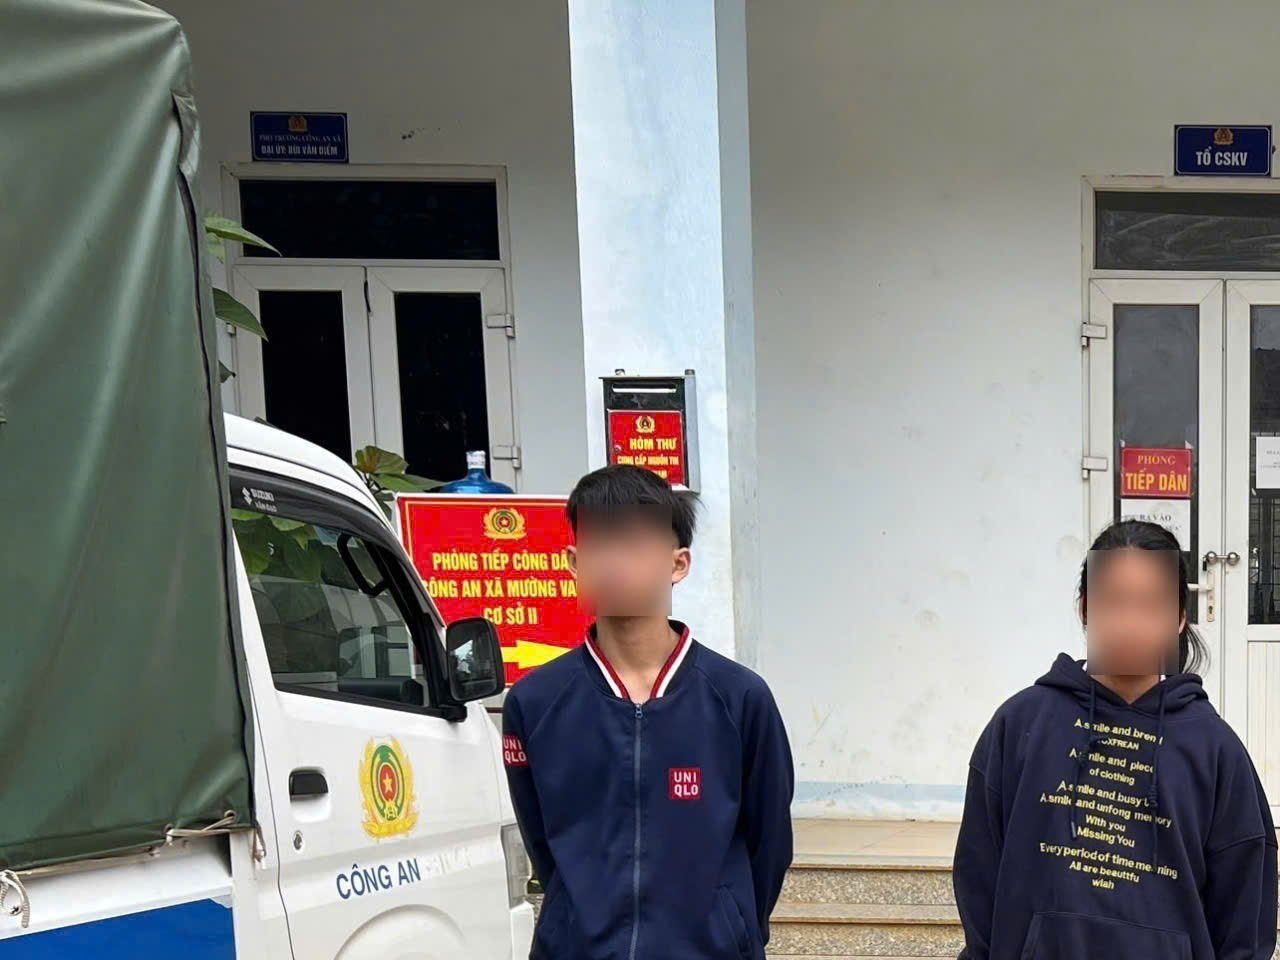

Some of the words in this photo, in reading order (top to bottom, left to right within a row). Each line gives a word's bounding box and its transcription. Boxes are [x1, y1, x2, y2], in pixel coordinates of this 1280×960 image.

[1195, 145, 1211, 166] TỔ
[1215, 151, 1248, 166] CSKV
[630, 436, 654, 450] HÒM
[656, 437, 677, 450] THƯ
[1126, 468, 1155, 490] TIẾP
[1160, 470, 1187, 491] DÂN
[432, 548, 478, 571] PHÒNG
[481, 547, 509, 571] TIẾP
[513, 549, 548, 571] CÔNG
[551, 550, 569, 571] DÂ
[462, 580, 482, 598] AN
[485, 577, 504, 598] XÃ
[508, 576, 556, 598] MƯỜNG
[560, 580, 577, 597] VA
[483, 606, 504, 625] CƠ
[506, 602, 525, 625] SỞ
[528, 608, 539, 625] II
[1074, 718, 1082, 728] A
[1112, 726, 1131, 736] and
[504, 738, 522, 750] UNI
[505, 750, 527, 764] QLO
[1069, 748, 1077, 758] A
[1107, 757, 1126, 768] and
[674, 771, 697, 783] UNI
[1089, 768, 1100, 776] of
[1100, 770, 1135, 786] clothing
[674, 783, 699, 798] QLO
[1056, 780, 1067, 792] A
[1097, 789, 1115, 800] and
[1118, 792, 1141, 807] busy
[1040, 792, 1047, 802] A
[1076, 799, 1096, 809] and
[1085, 814, 1106, 827] With
[1108, 821, 1126, 832] you
[1077, 825, 1116, 845] Missing
[1117, 834, 1135, 848] You
[1040, 842, 1064, 856] Every
[1063, 846, 1098, 859] period
[1098, 852, 1111, 863] of
[1112, 854, 1134, 868] time
[1135, 861, 1178, 880] mening
[1069, 860, 1082, 871] All
[1082, 863, 1098, 874] are
[336, 863, 392, 900] CÔNG
[398, 858, 421, 886] AN
